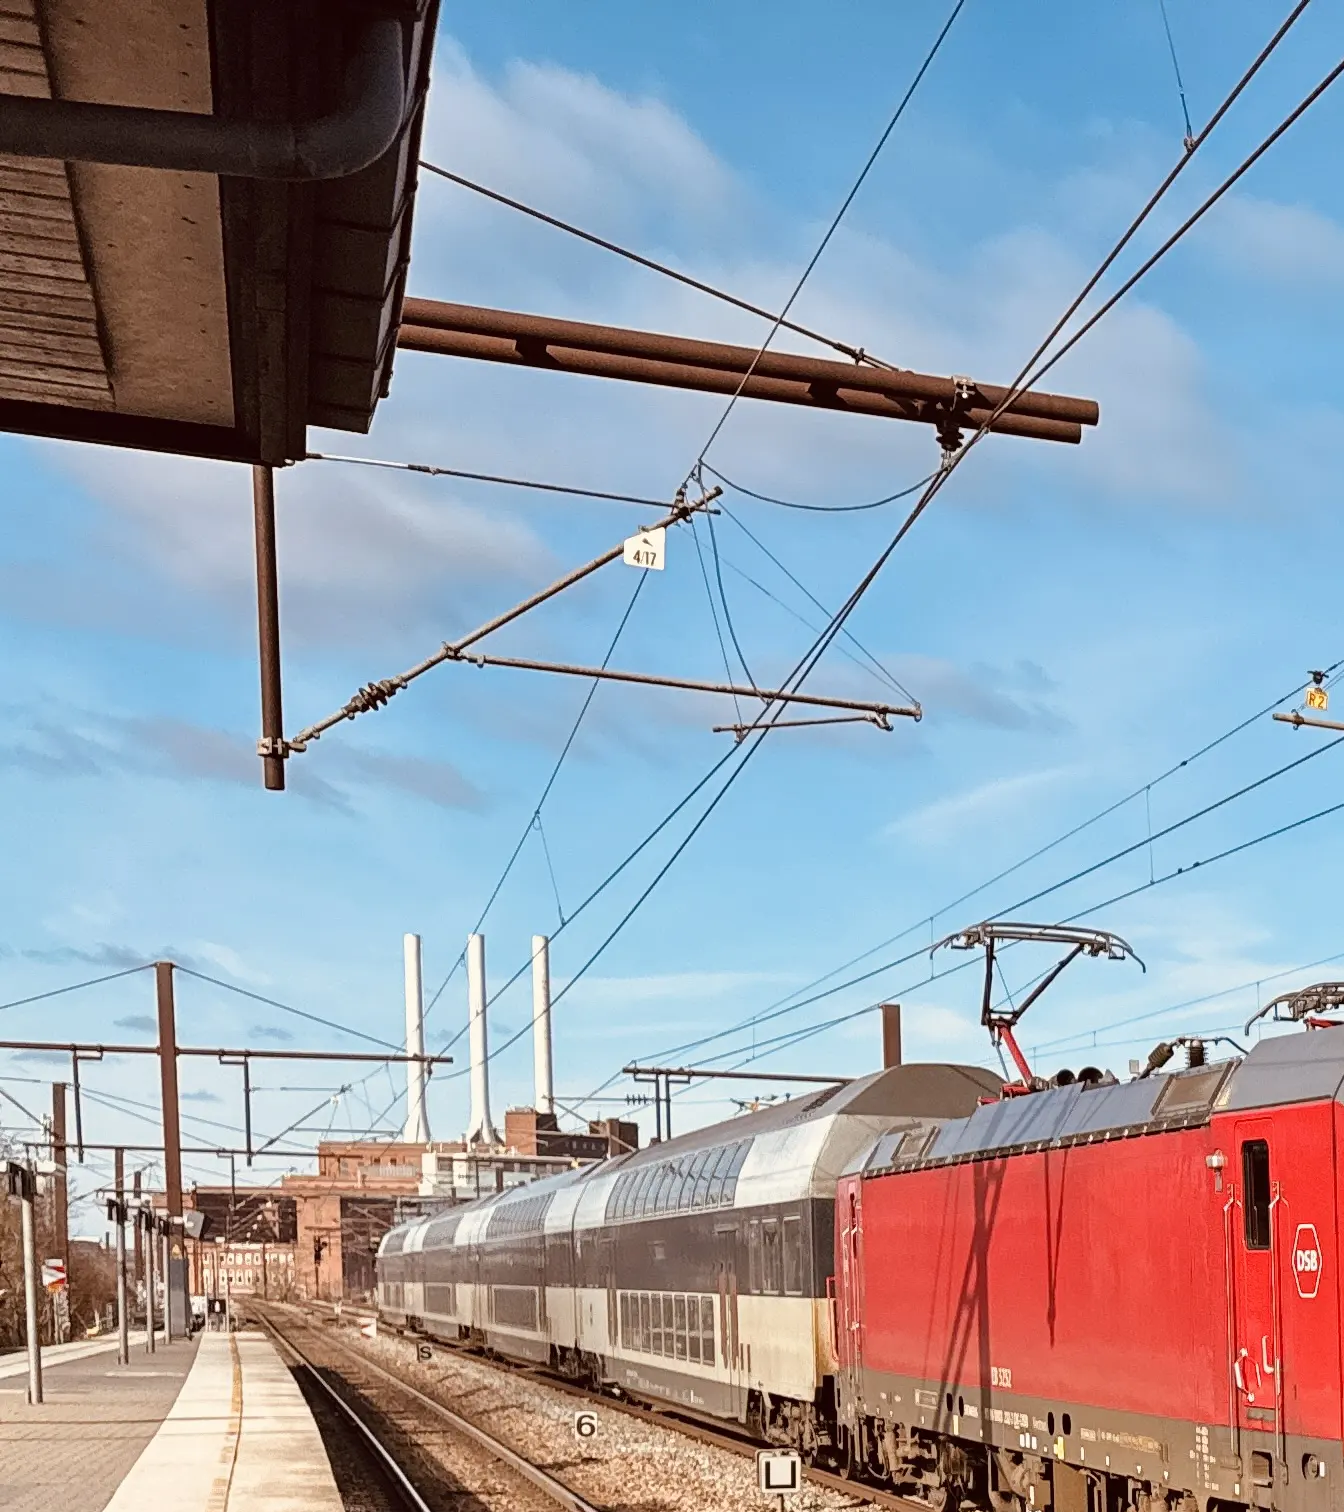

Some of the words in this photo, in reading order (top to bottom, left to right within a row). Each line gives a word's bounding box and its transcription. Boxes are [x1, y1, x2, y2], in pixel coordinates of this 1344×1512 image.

[632, 549, 657, 567] 4/17
[1296, 1249, 1318, 1272] DSB
[420, 1345, 432, 1359] S
[576, 1414, 596, 1437] 6
